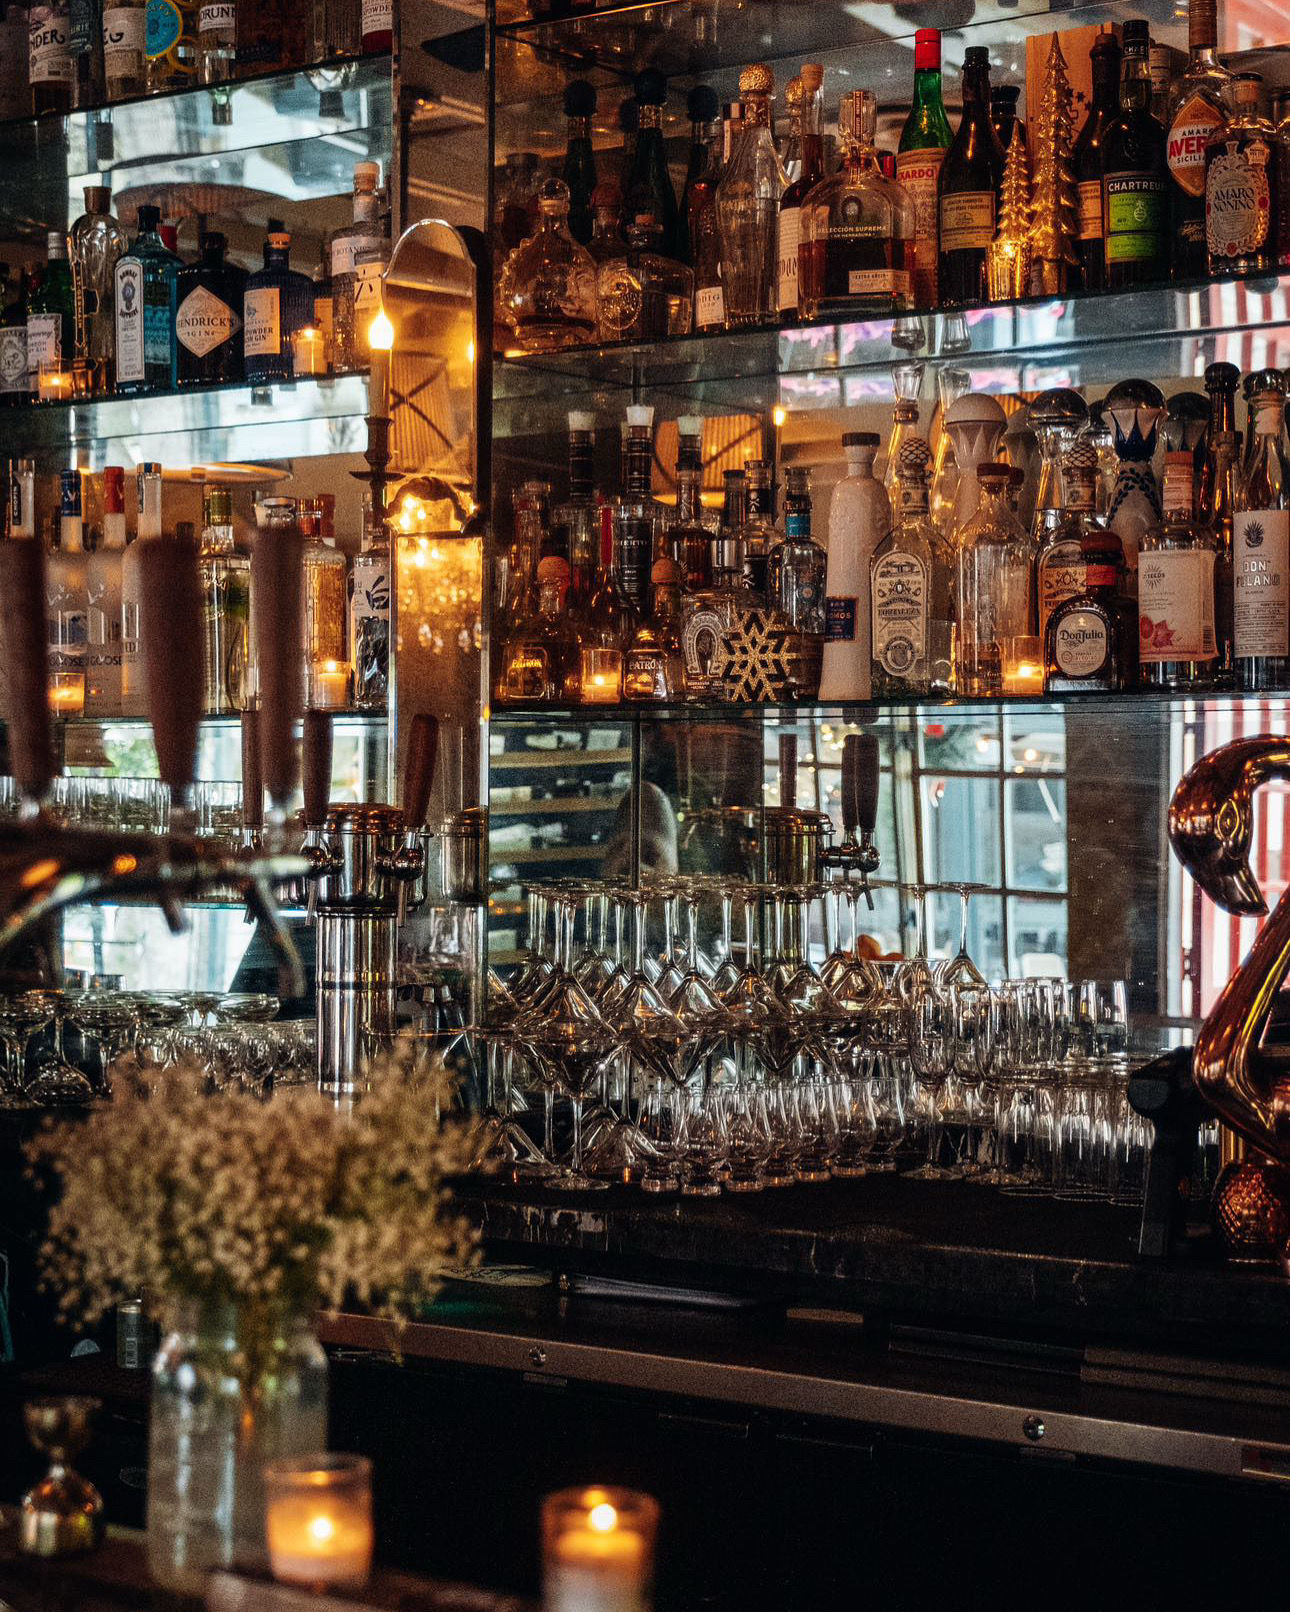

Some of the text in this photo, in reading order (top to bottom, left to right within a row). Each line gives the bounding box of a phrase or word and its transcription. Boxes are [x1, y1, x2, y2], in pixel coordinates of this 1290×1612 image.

[1214, 188, 1254, 200] AMARO
[1213, 199, 1254, 213] NONINO
[1243, 561, 1267, 573] DON
